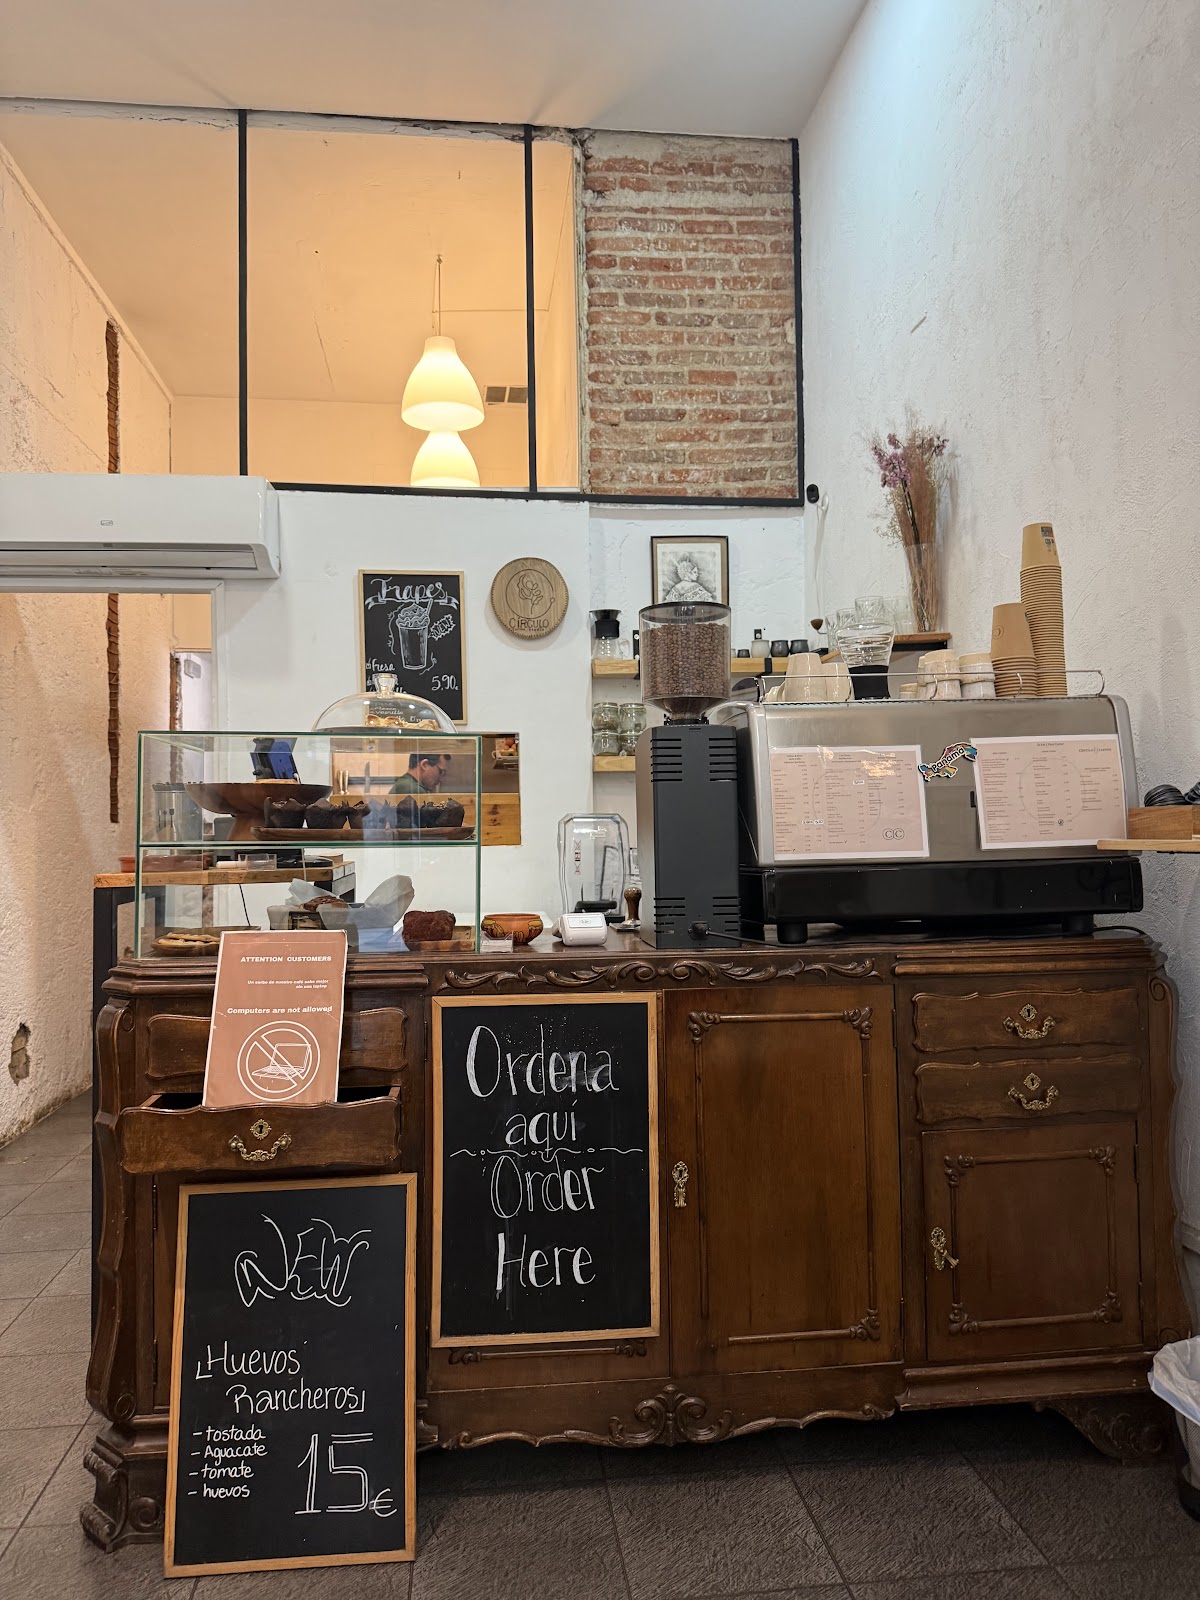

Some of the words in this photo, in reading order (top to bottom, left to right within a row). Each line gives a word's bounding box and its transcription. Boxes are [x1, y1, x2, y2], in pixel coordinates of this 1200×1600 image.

[931, 747, 965, 772] Panama
[227, 1007, 270, 1015] Computers
[466, 1023, 619, 1098] Ordena
[505, 1100, 578, 1162] aquí
[490, 1155, 605, 1218] Order
[496, 1232, 596, 1291] Here
[204, 1442, 268, 1466] Aguacate
[201, 1463, 255, 1479] tomate
[203, 1483, 251, 1498] huevos
